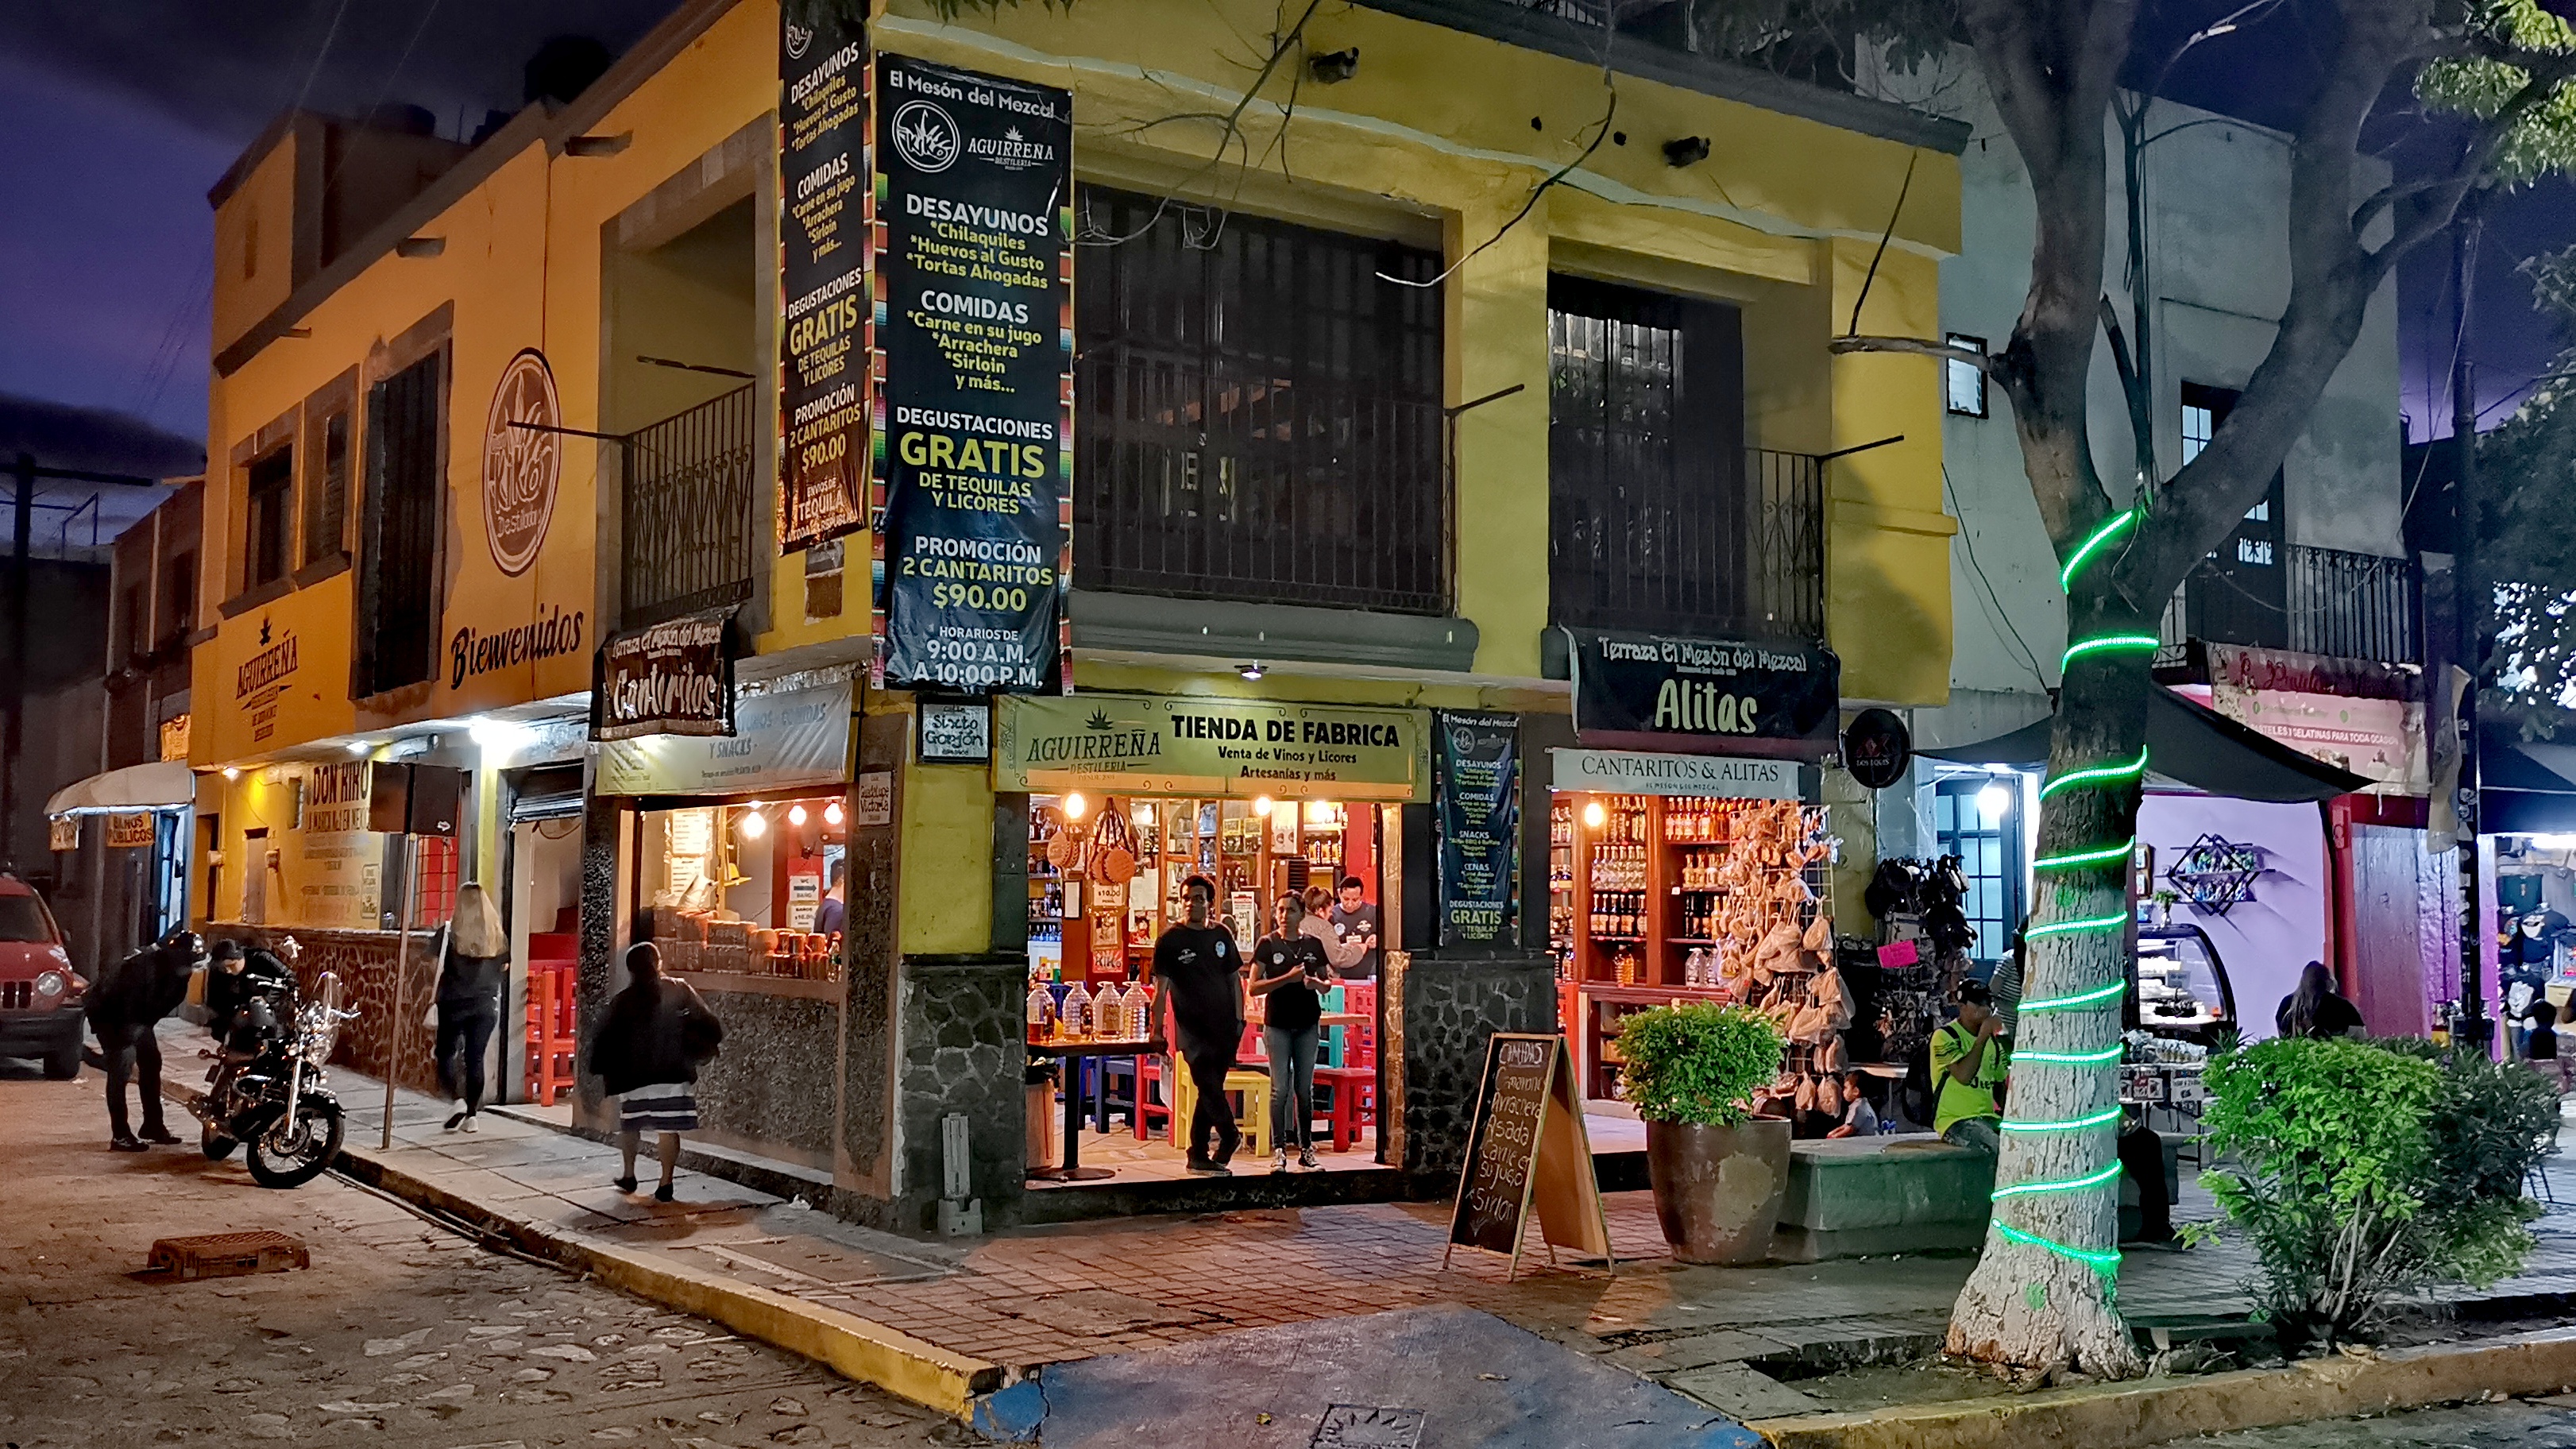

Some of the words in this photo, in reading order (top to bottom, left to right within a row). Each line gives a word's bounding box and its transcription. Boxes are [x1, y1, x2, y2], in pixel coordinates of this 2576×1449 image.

[791, 41, 859, 105] DESAYUNOS
[830, 86, 857, 109] Gusto
[890, 70, 903, 89] El
[908, 75, 963, 101] Mesón
[967, 87, 994, 106] del
[998, 94, 1054, 118] Mezcal
[818, 102, 859, 133] Ahogadas
[798, 152, 848, 199] COMIDAS
[836, 175, 855, 198] jugo
[906, 193, 1049, 237] DESAYUNOS
[980, 247, 994, 264] al
[998, 250, 1045, 271] Gusto
[970, 264, 1049, 289] Ahogadas
[789, 268, 861, 319] DEGUSTACIONES
[921, 289, 1029, 324] COMIDAS
[790, 294, 857, 356] GRATIS
[964, 323, 983, 335] en
[987, 327, 1005, 338] su
[1007, 325, 1042, 346] jugo
[798, 354, 809, 373] DE
[810, 334, 851, 367] TEQUILAS
[803, 371, 809, 388] Y
[810, 355, 845, 384] LICORES
[955, 374, 965, 390] y
[795, 382, 855, 426] PROMOCIÓN
[790, 431, 796, 449] 2
[798, 403, 860, 445] CANTARITOS
[897, 407, 1052, 440] DEGUSTACIONES
[802, 433, 846, 473] $90.00
[900, 431, 1045, 478] GRATIS
[919, 471, 943, 489] DE
[946, 475, 1031, 497] TEQUILAS
[799, 489, 843, 521] TEQUILA
[932, 491, 944, 507] Y
[948, 493, 1020, 514] LICORES
[915, 535, 1041, 563] PROMOCIÓN
[903, 557, 915, 576] 2
[920, 558, 1053, 585] CANTARITOS
[933, 582, 1027, 612] $90.00
[450, 601, 584, 690] Bienvenidos
[939, 626, 1003, 640] HORARIOS
[1003, 630, 1018, 641] DE
[927, 639, 977, 661] 9:00
[983, 643, 1030, 664] A.M.
[1597, 636, 1659, 662] Terraza
[1733, 647, 1755, 670] del
[1758, 649, 1807, 672] Mezcal
[913, 662, 929, 682] A
[935, 663, 994, 684] 10:00
[999, 666, 1044, 687] P.M.
[614, 662, 716, 719] Cantaritos
[933, 714, 978, 729] Sixto
[1655, 679, 1758, 734] Alitas
[1026, 728, 1161, 762] AGUIRREÑA
[1171, 715, 1258, 741] TIENDA
[1266, 719, 1295, 744] DE
[1303, 721, 1400, 748] FABRICA
[716, 740, 752, 757] SNACKS
[1218, 745, 1253, 759] Venta
[1255, 747, 1269, 760] de
[1273, 747, 1305, 762] Vinos
[1307, 752, 1315, 764] y
[1318, 750, 1357, 763] Licores
[313, 763, 338, 806] DON
[1241, 765, 1301, 780] Artesanías
[1303, 770, 1311, 782] y
[1314, 768, 1336, 782] más
[1582, 756, 1697, 779] CANTARITOS
[1701, 762, 1717, 779] &
[1721, 763, 1778, 782] ALITAS
[1459, 792, 1494, 802] COMIDAS
[1450, 910, 1501, 925] GRATIS
